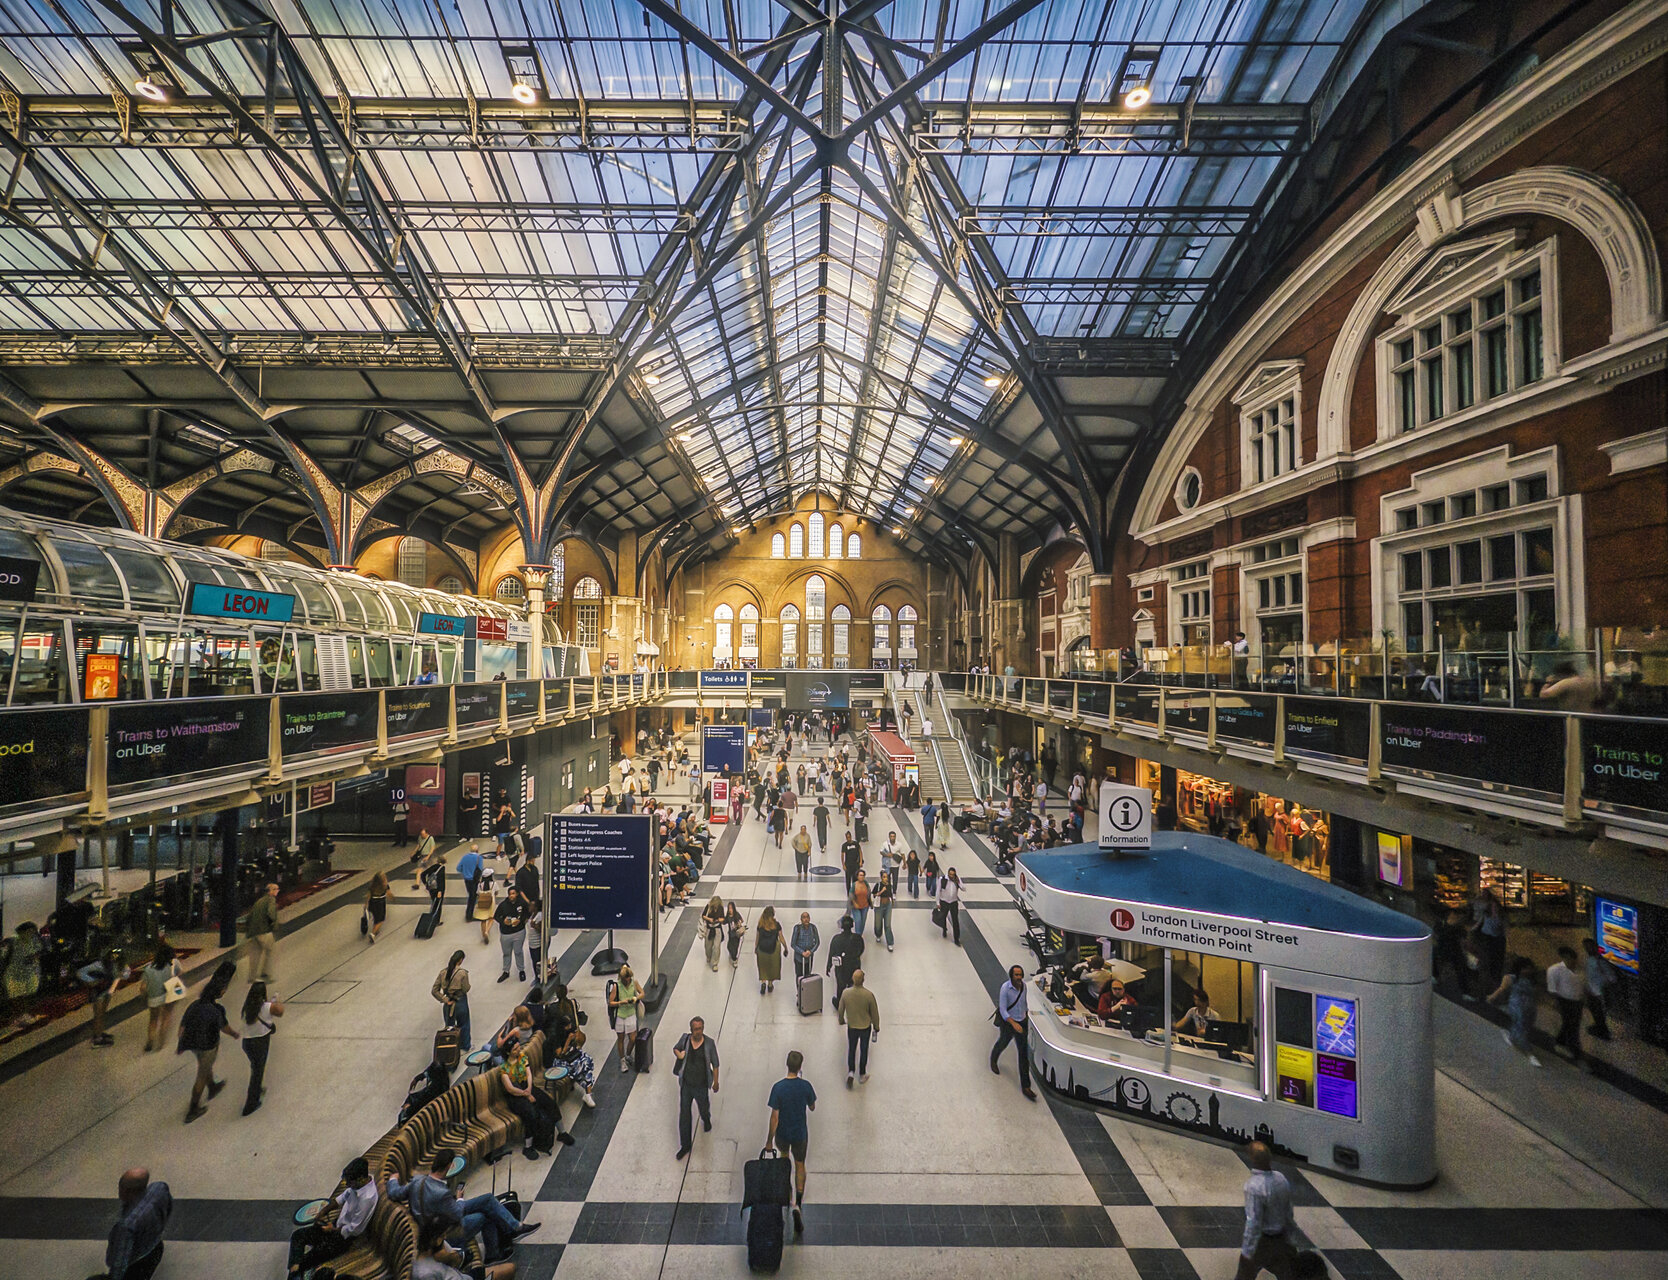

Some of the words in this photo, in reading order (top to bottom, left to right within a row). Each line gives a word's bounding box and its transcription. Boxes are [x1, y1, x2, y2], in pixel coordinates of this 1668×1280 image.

[223, 594, 270, 615] LEON
[434, 618, 454, 631] LEON
[510, 622, 518, 632] Free
[286, 714, 307, 723] Trains
[317, 710, 346, 720] Braintree
[1288, 713, 1306, 722] Trains
[1307, 716, 1313, 724] to
[1315, 716, 1338, 726] Enfield
[117, 730, 153, 743] Trains
[156, 729, 168, 740] to
[171, 722, 240, 737] Walthamstow
[285, 728, 295, 736] on
[296, 725, 314, 734] Uber
[1297, 724, 1312, 733] Uber
[1386, 724, 1410, 735] Trains
[1413, 726, 1424, 736] to
[1425, 728, 1486, 744] Paddington
[0, 740, 34, 756] ood
[116, 748, 133, 758] on
[136, 742, 166, 756] Uber
[1386, 737, 1398, 746] on
[1400, 737, 1421, 749] Uber
[1594, 745, 1640, 762] Trains
[1645, 750, 1662, 765] to
[1593, 764, 1614, 775] on
[1619, 765, 1659, 781] Uber
[391, 789, 404, 800] 10
[1102, 835, 1148, 843] Information
[1142, 912, 1187, 927] London
[1191, 919, 1252, 938] Liverpool
[1255, 929, 1298, 945] Street
[1142, 925, 1215, 946] Information
[1219, 938, 1252, 953] Point
